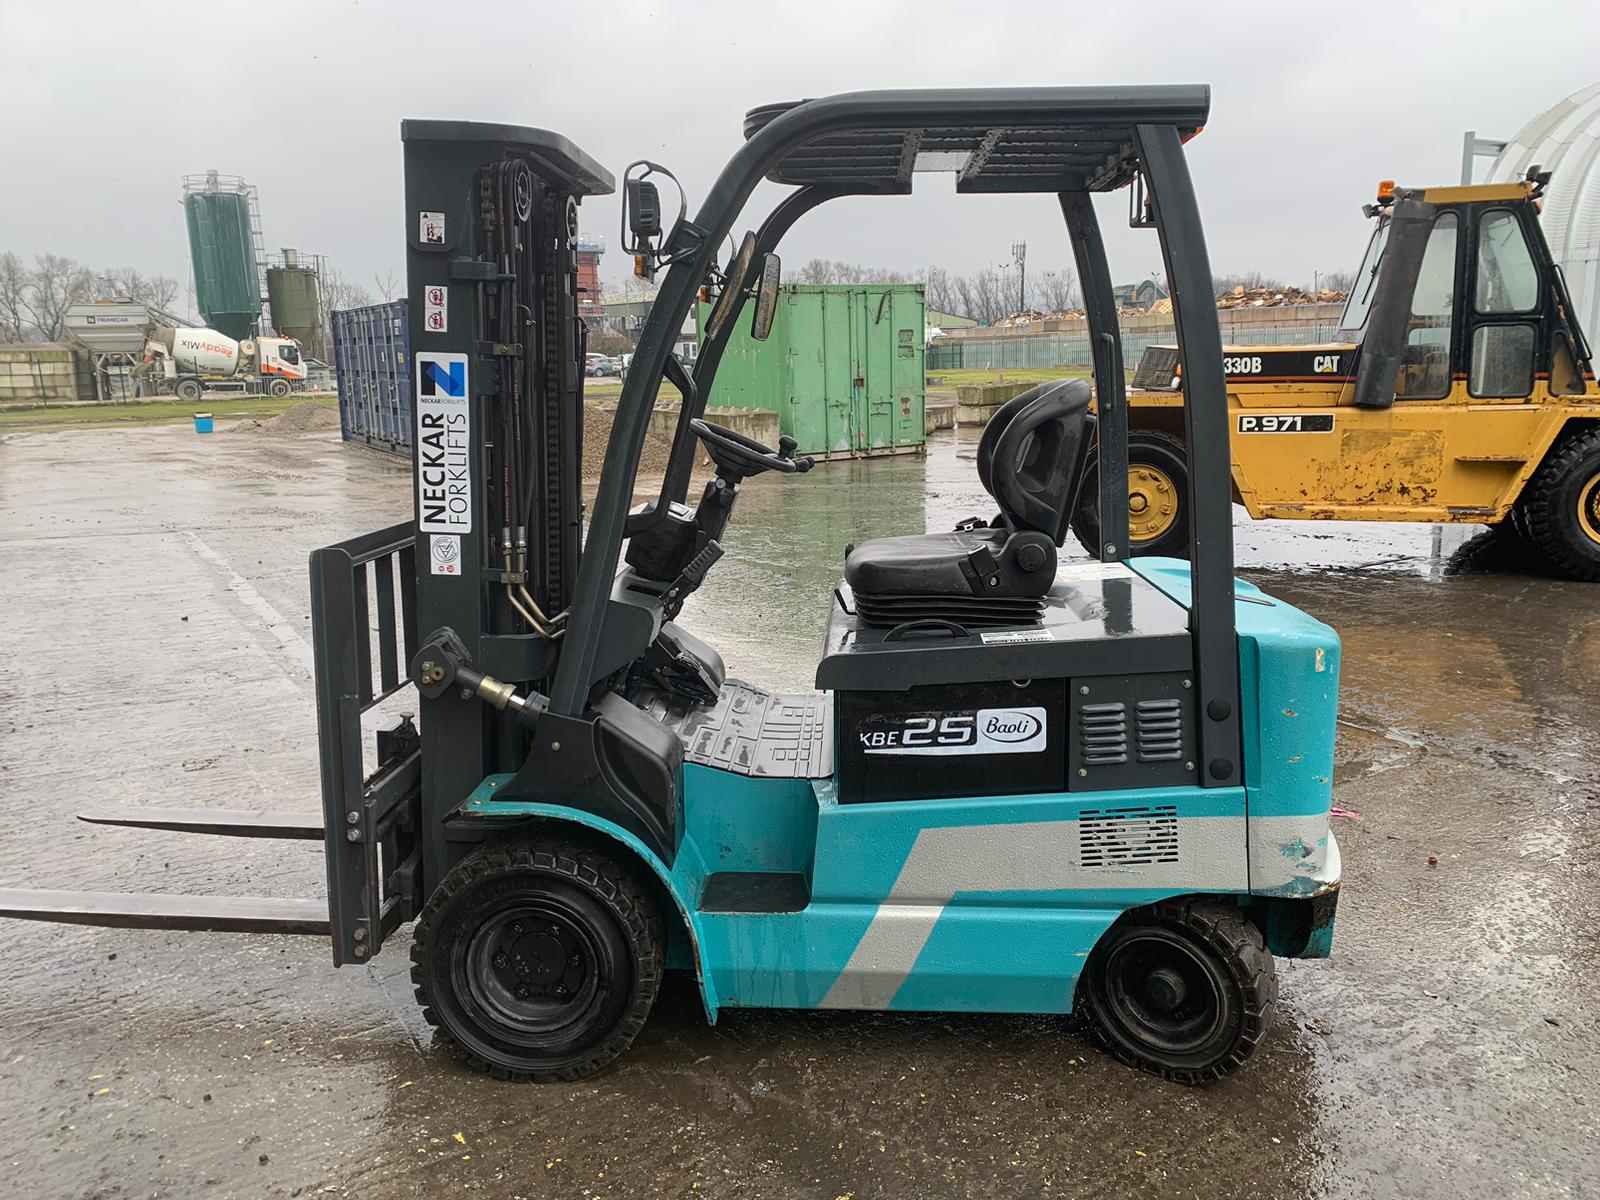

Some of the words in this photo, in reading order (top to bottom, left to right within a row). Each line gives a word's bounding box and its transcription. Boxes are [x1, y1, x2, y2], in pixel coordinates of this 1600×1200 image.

[1224, 357, 1262, 374] 330B
[1313, 355, 1340, 373] CAT
[422, 413, 446, 524] NECKAR
[447, 413, 468, 524] FORKLIFTS
[860, 731, 899, 747] KBE
[902, 716, 974, 745] 25
[985, 716, 1030, 734] Baoli
